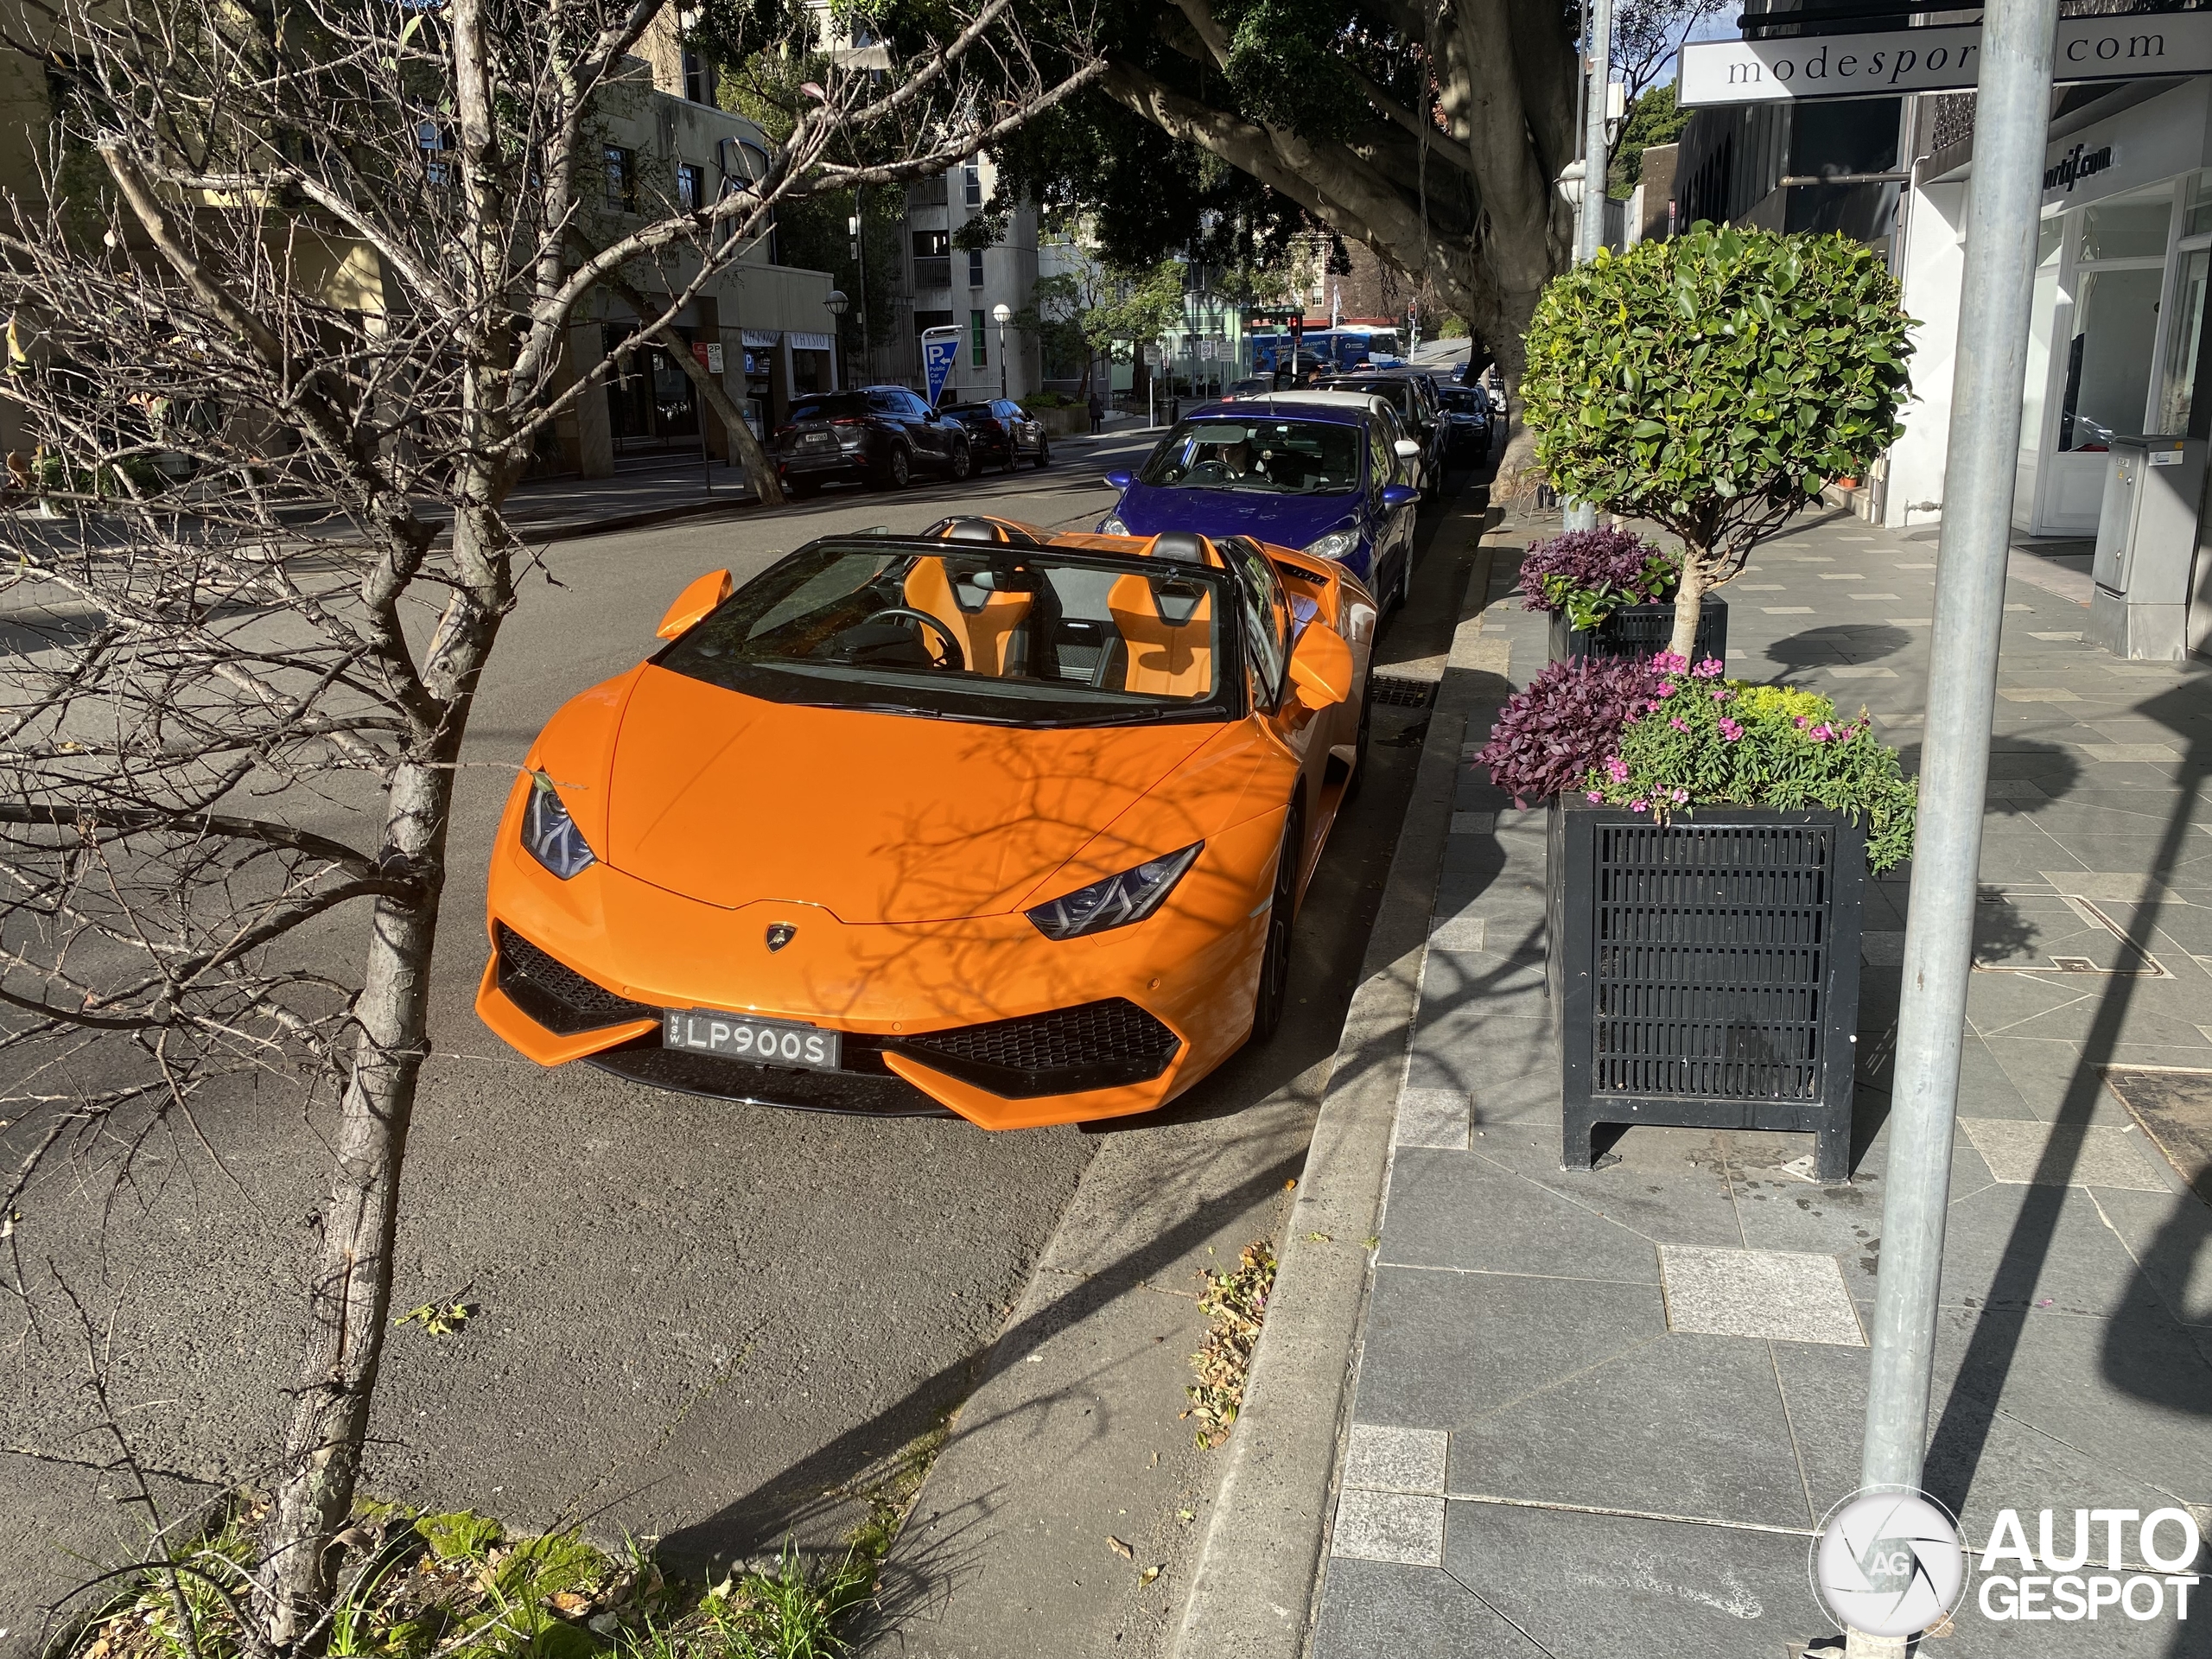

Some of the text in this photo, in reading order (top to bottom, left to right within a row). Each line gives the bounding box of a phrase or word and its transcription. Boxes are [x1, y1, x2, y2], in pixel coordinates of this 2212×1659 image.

[1727, 30, 2165, 85] modesporcom
[2043, 143, 2112, 193] ortif.com
[743, 330, 778, 345] PHYSIO
[794, 334, 826, 347] PHYSIO
[746, 354, 752, 369] P
[929, 346, 944, 364] P
[669, 1014, 680, 1044] NSW
[687, 1019, 825, 1063] LP900S
